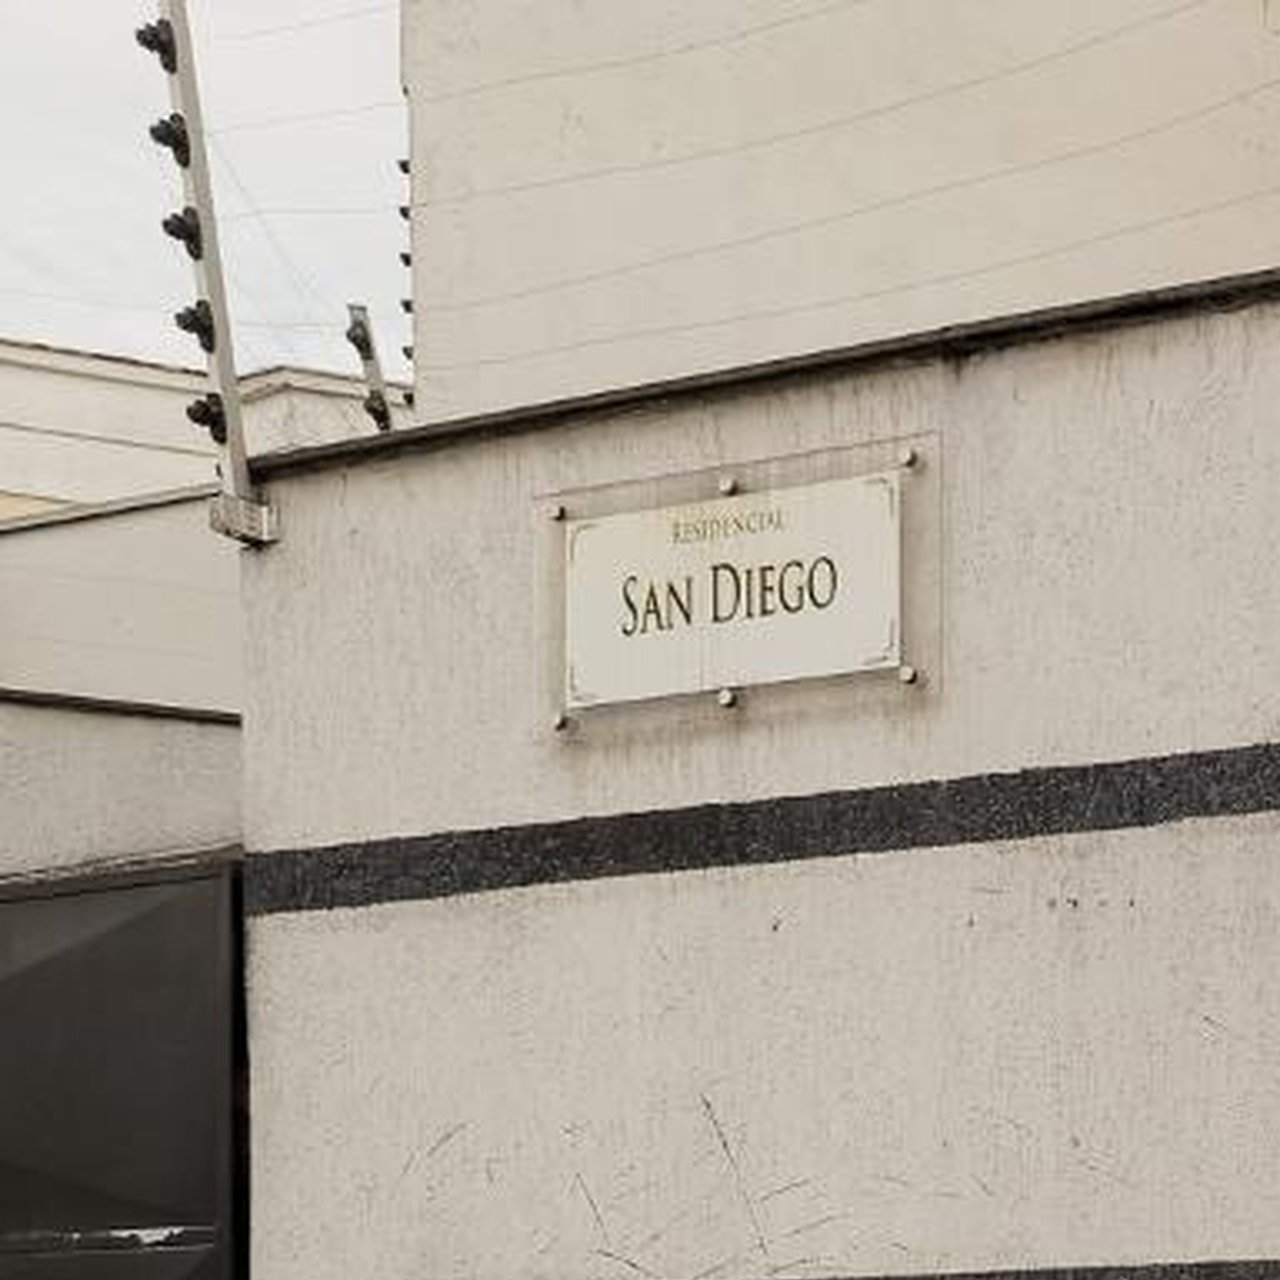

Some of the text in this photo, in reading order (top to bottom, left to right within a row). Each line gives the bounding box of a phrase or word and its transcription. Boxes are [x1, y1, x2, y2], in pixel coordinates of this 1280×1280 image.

[672, 507, 782, 544] RESIDENCIAL
[621, 555, 839, 637] SAN DIEGO
